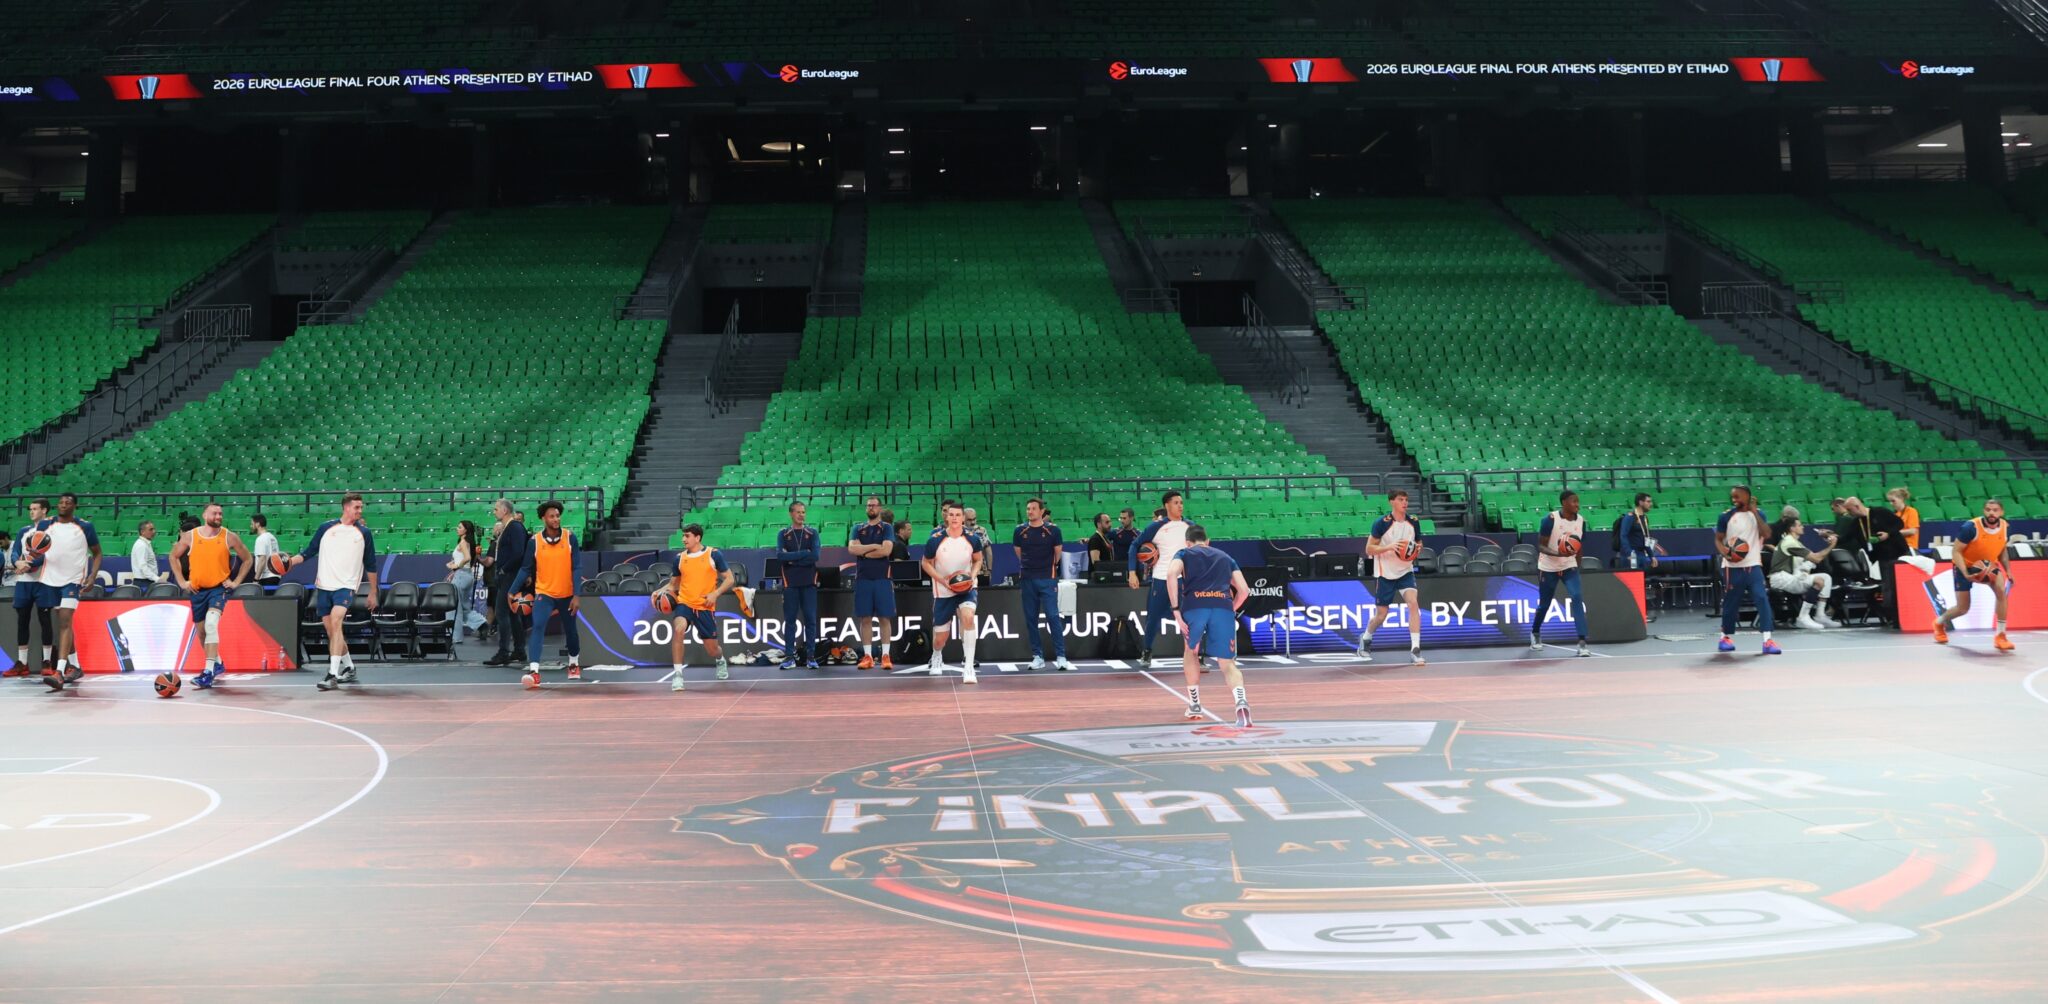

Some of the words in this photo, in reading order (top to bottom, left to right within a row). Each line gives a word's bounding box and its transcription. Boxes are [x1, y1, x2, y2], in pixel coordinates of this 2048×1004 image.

[801, 69, 859, 80] EuroLeague
[1131, 65, 1187, 77] EuroLeague
[1367, 63, 1398, 74] 2026
[1401, 63, 1477, 76] EUROLEAGUE
[1480, 63, 1513, 74] FINAL
[1516, 63, 1548, 74] FOUR
[1551, 63, 1596, 74] ATHENS
[1599, 63, 1665, 75] PRESENTED
[1668, 63, 1683, 74] BY
[1687, 63, 1729, 74] ETIHAD
[1920, 65, 1974, 76] EuroLeague
[213, 79, 245, 90] 2026
[249, 77, 326, 90] EUROLEAGUE
[329, 77, 363, 88] FINAL
[367, 75, 400, 86] FOUR
[403, 75, 450, 86] ATHENS
[454, 73, 524, 86] PRESENTED
[527, 73, 544, 83] BY
[548, 71, 592, 83] ETIHAD
[1246, 586, 1283, 597] ALDING
[1038, 612, 1111, 637] UR
[1431, 601, 1471, 626] BY
[1128, 735, 1382, 749] EuroLeague
[1384, 768, 1893, 814] FOUR
[0, 813, 152, 829] D
[1277, 832, 1552, 853] ATHENS
[1314, 908, 1782, 943] ETIHAD
